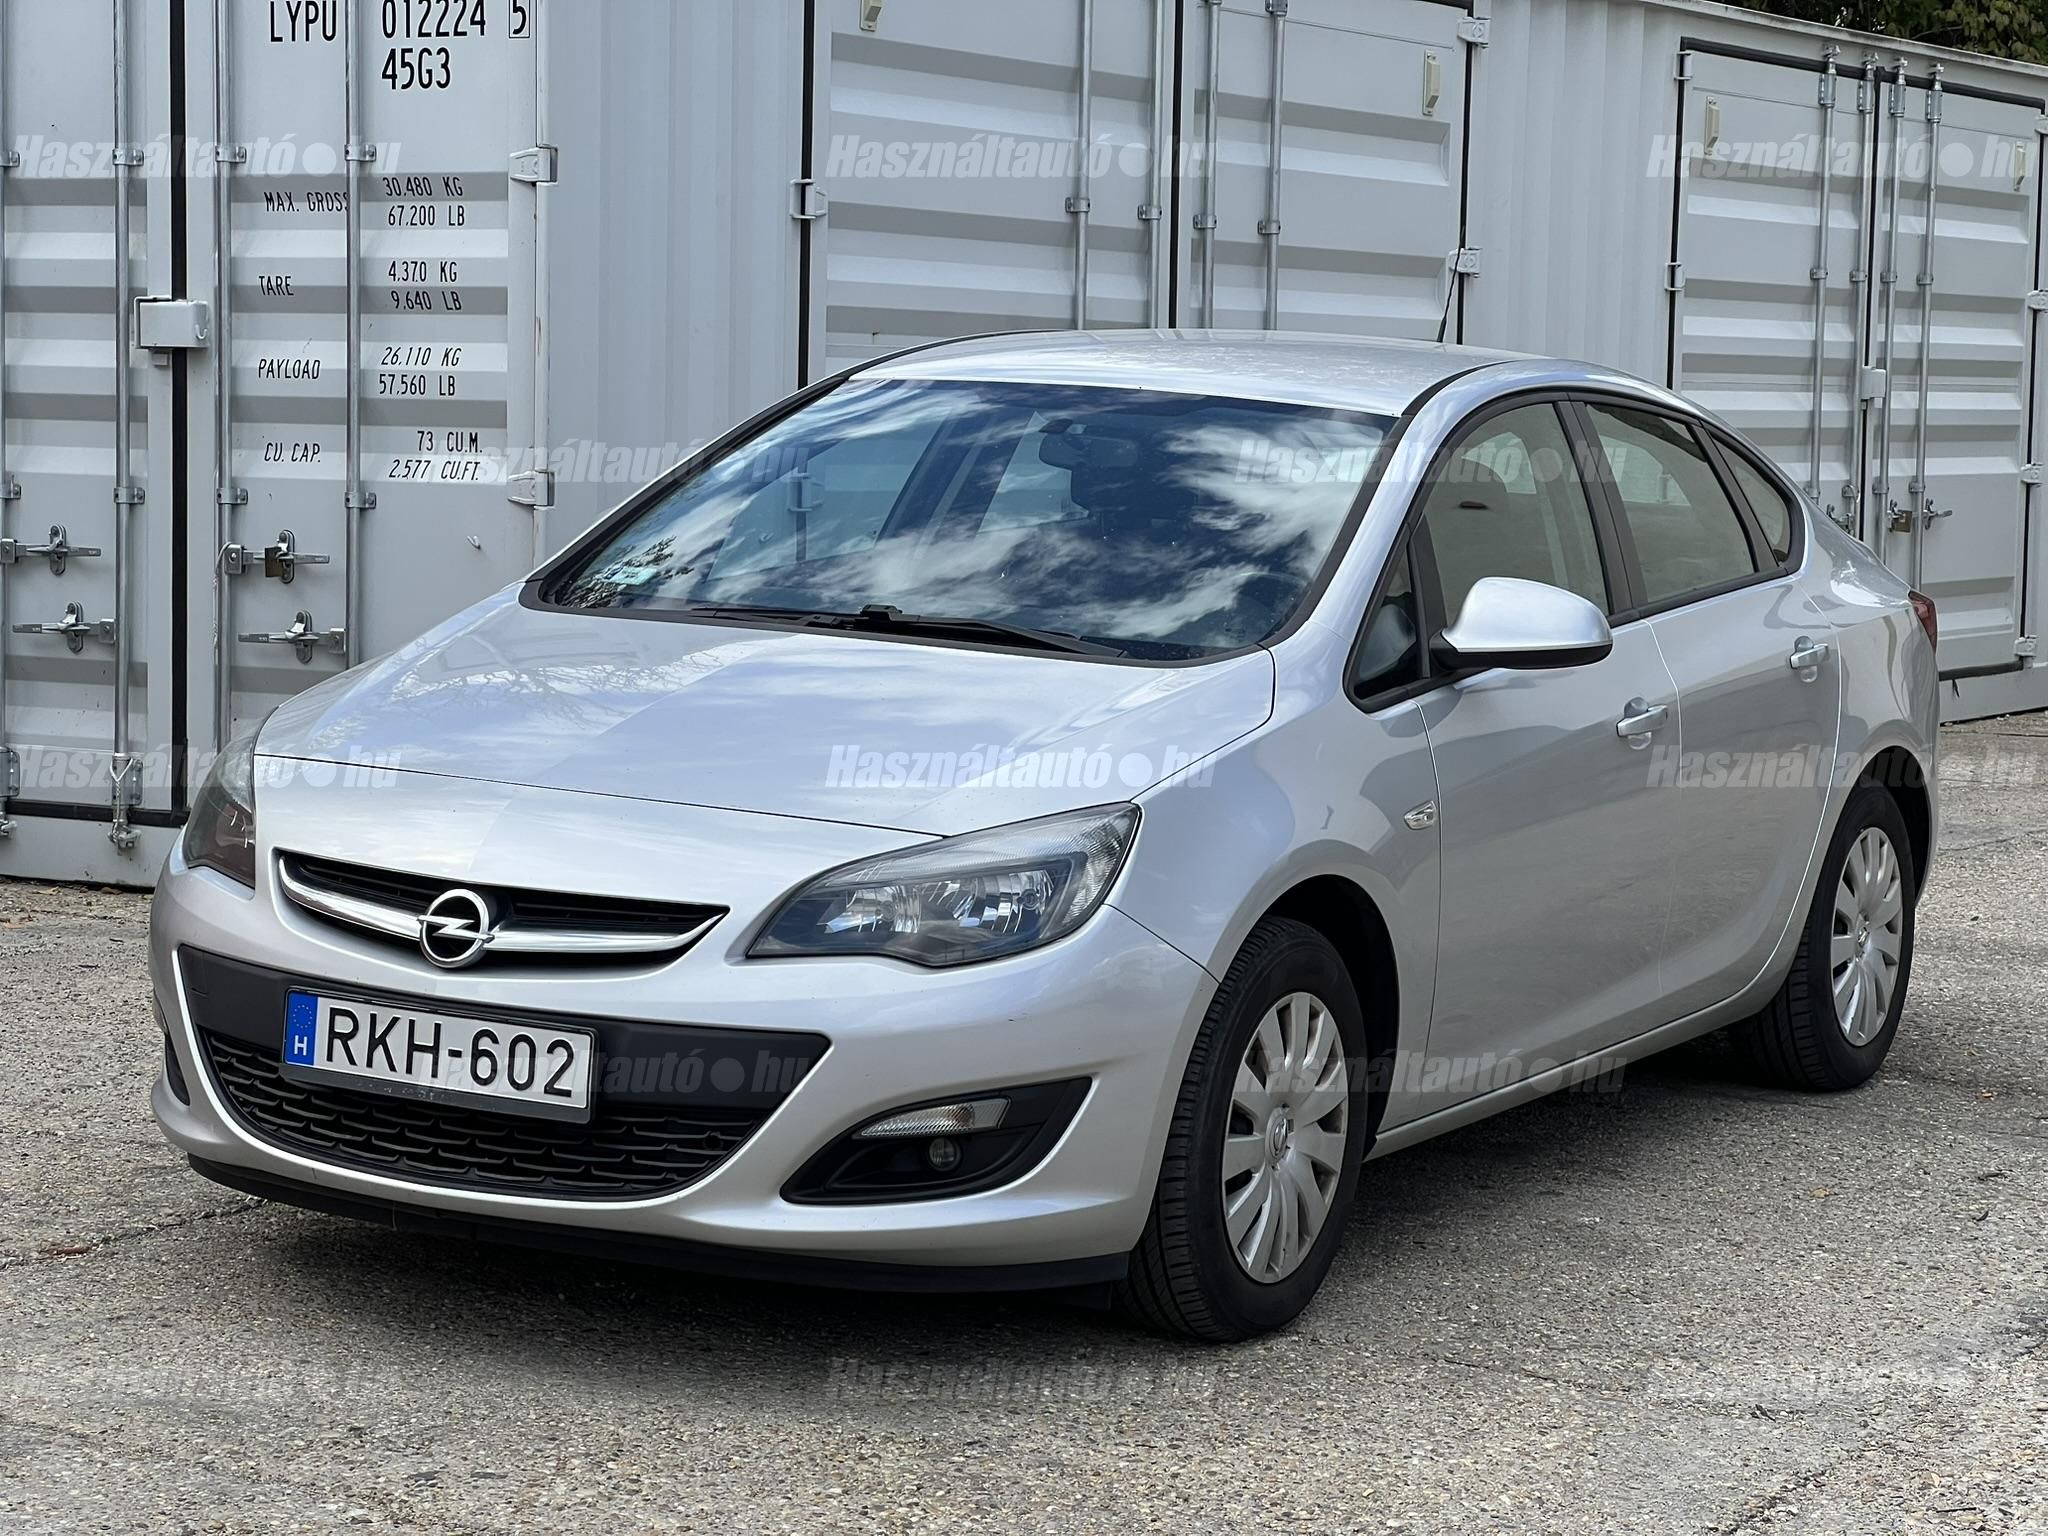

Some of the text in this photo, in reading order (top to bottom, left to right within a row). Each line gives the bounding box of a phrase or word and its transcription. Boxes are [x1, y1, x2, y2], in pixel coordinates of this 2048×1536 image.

[270, 0, 528, 42] LYPU 012224 5
[381, 47, 452, 90] 45G3
[442, 176, 464, 197] KG
[264, 192, 300, 212] MAX.
[448, 205, 465, 226] LB
[440, 261, 458, 282] KG
[259, 276, 295, 296] TARE
[442, 291, 462, 310] LB
[441, 347, 462, 367] KG
[258, 358, 321, 379] PAYLOAD
[439, 374, 455, 396] LB
[417, 430, 483, 453] 73 CU.M.
[264, 442, 321, 463] CU. CAP.
[293, 1006, 575, 1098] H RKH-602
